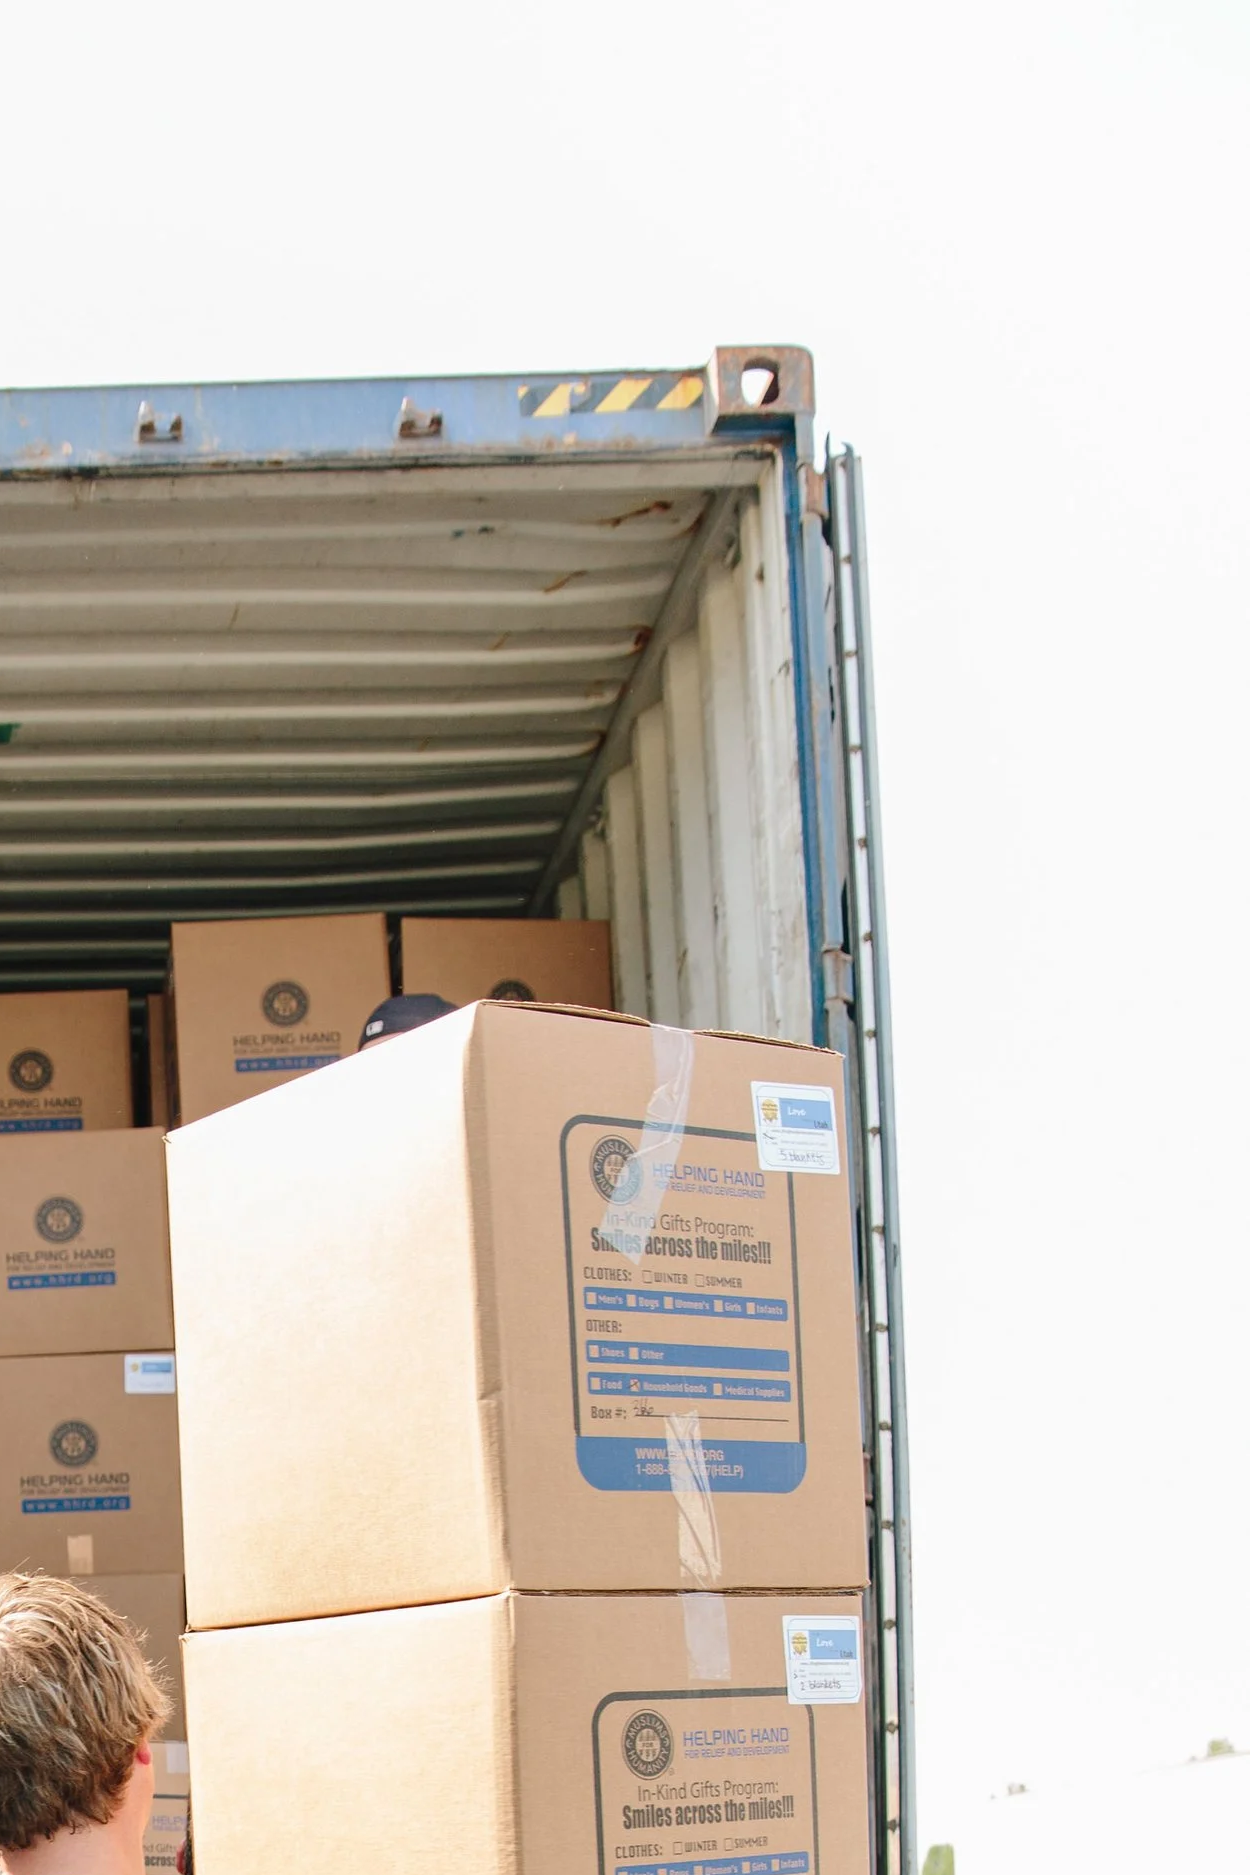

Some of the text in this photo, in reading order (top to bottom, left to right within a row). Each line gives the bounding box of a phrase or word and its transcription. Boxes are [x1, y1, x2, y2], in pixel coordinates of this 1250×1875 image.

[231, 1031, 341, 1047] HELPING HAND
[44, 1096, 82, 1108] HAND
[786, 1106, 807, 1116] Love
[652, 1162, 765, 1188] HELPING HAND
[670, 1182, 696, 1193] RELIEF
[698, 1185, 714, 1195] AND
[714, 1187, 766, 1200] DEVELOPMENT
[607, 1211, 754, 1241] In-Kind Gifts Program:
[590, 1227, 772, 1265] Smiles across the miles!!!
[6, 1248, 116, 1264] HELPING HAND
[10, 1273, 113, 1288] www.hhrd.org
[583, 1266, 743, 1289] CLOTHES: WINTER SUMMER
[756, 1304, 783, 1315] Infants
[585, 1319, 623, 1334] OTHER:
[601, 1380, 623, 1390] Food
[590, 1406, 612, 1420] Box
[20, 1472, 130, 1488] HELPING HAND
[25, 1496, 128, 1512] www.hhrd.org
[816, 1638, 834, 1647] Love
[627, 1713, 669, 1739] MUSLIMS
[683, 1727, 789, 1747] HELPING HAND
[684, 1745, 790, 1759] FOR RELIEF AND DEVELOPMENT
[627, 1749, 670, 1774] HUMANITY
[638, 1779, 779, 1802] In-Kind Gifts Program:
[623, 1795, 795, 1830] Smiles across the miles!!!
[615, 1836, 768, 1859] CLOTHES: WINTER SUMMER
[780, 1858, 805, 1869] Infants
